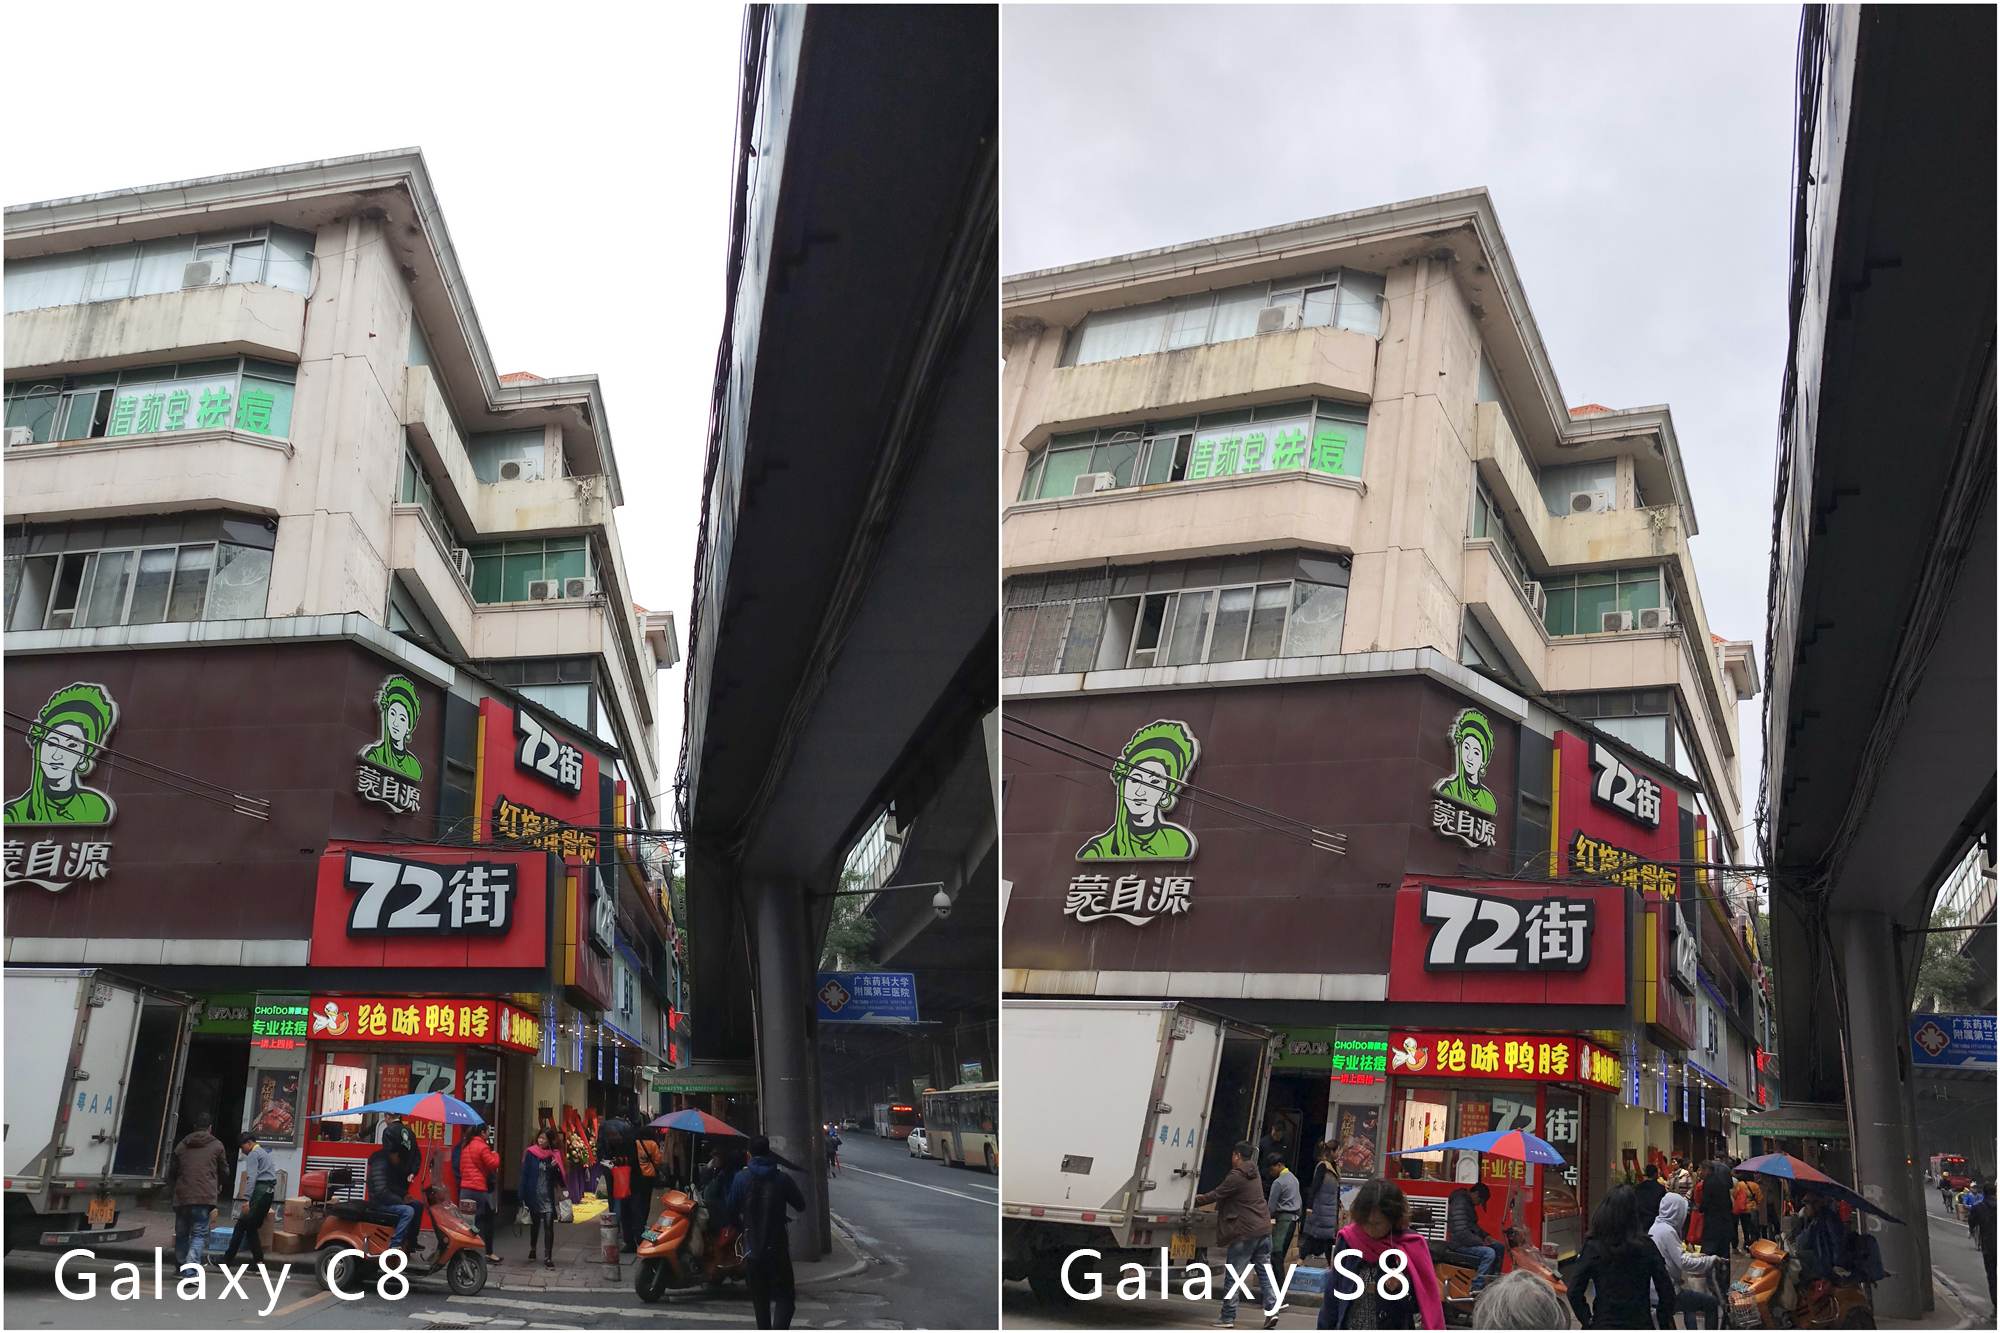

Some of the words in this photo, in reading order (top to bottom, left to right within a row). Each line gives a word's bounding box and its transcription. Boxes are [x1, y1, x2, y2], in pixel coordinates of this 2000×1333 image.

[196, 386, 275, 435] 祛痘
[1272, 428, 1348, 475] 祛痘
[518, 710, 583, 791] 72街
[357, 765, 421, 813] 蒙自源
[1595, 743, 1661, 826] 72街
[1431, 799, 1497, 847] 蒙自源
[350, 856, 509, 929] 72街
[1063, 874, 1195, 927] 蒙自源
[1426, 890, 1588, 965] 72街
[853, 976, 910, 987] 广东药科大学
[854, 986, 911, 998] 附属第三医院
[252, 1019, 308, 1036] 专业祛痘
[357, 1002, 490, 1038] 绝味鸭脖
[1332, 1054, 1387, 1071] 专业祛痘
[1437, 1037, 1570, 1075] 绝味鸭脖
